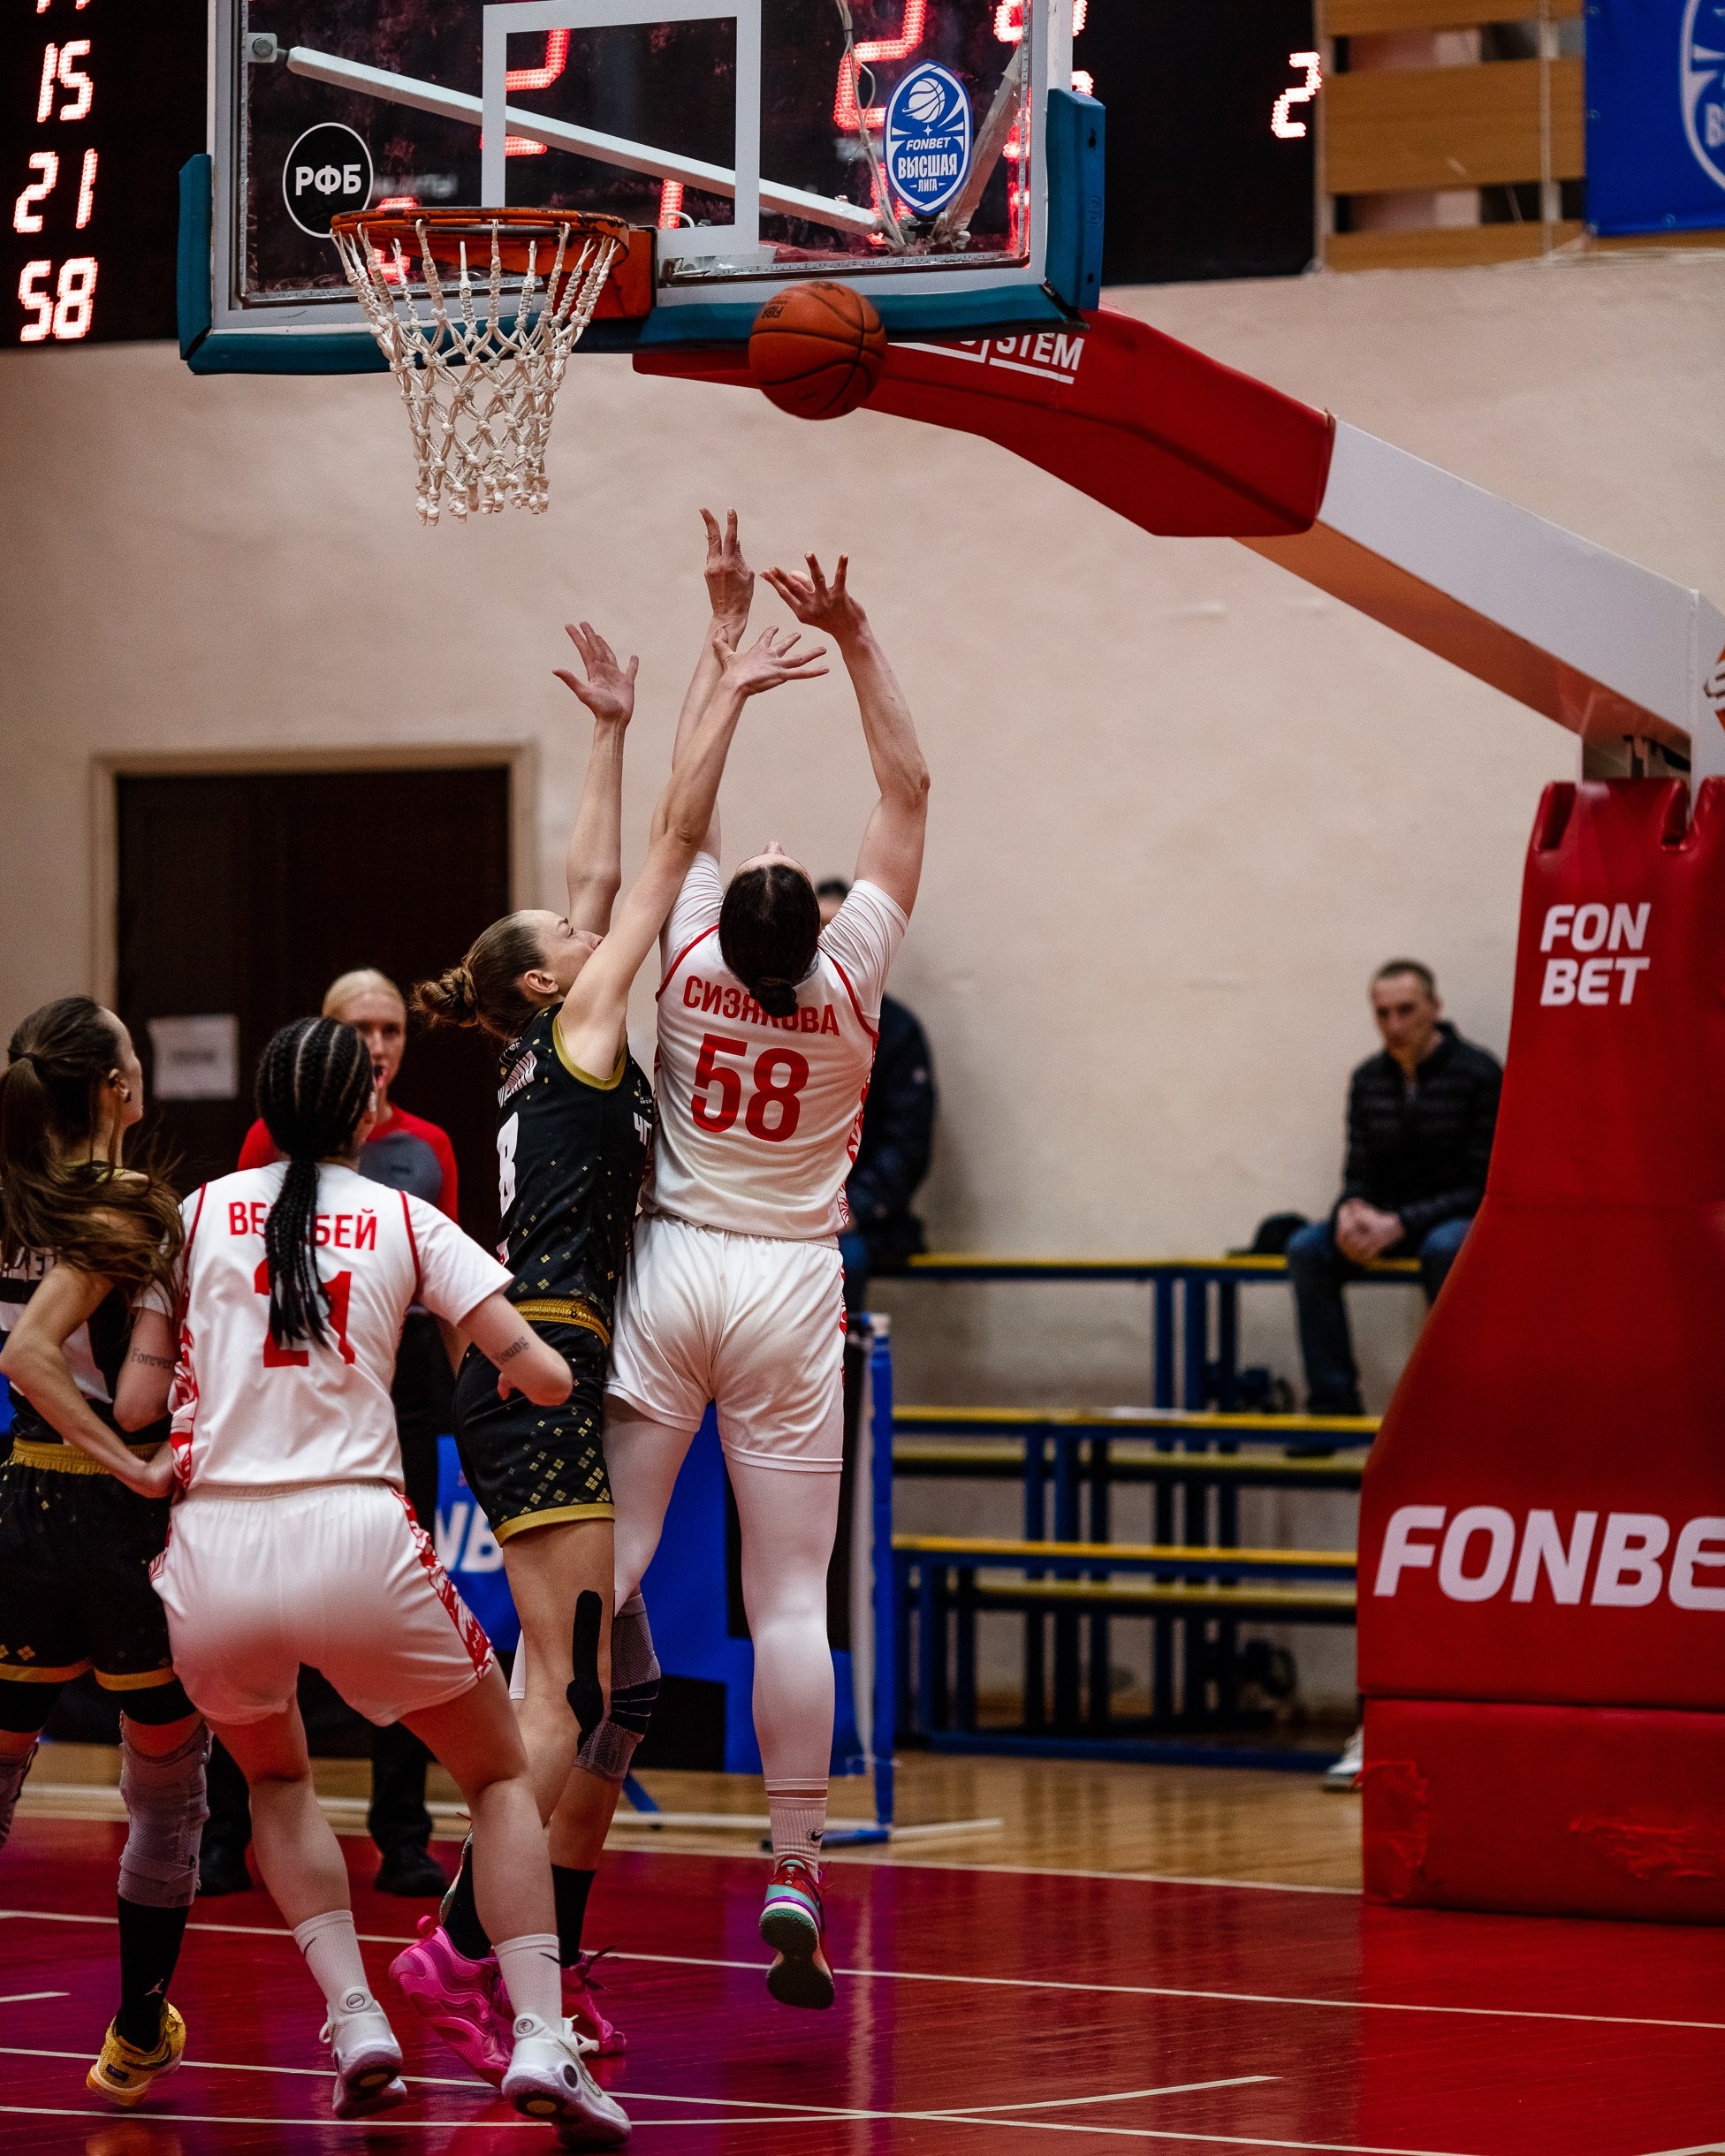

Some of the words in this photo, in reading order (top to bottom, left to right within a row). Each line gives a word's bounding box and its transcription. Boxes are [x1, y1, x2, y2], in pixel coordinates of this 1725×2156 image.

[36, 40, 94, 122] 15
[1271, 51, 1321, 138] 2
[898, 153, 957, 179] ВЫСШАЯ
[906, 136, 951, 151] FONBET
[13, 148, 97, 232] 21
[295, 163, 361, 196] РФБ
[917, 178, 938, 193] ЛИГА
[19, 256, 97, 342] 58
[761, 306, 784, 320] FIBA
[1539, 903, 1652, 953] FON
[1539, 957, 1651, 1006] BET
[690, 1032, 809, 1143] 58
[228, 1201, 377, 1251] ВЕБЕЙ
